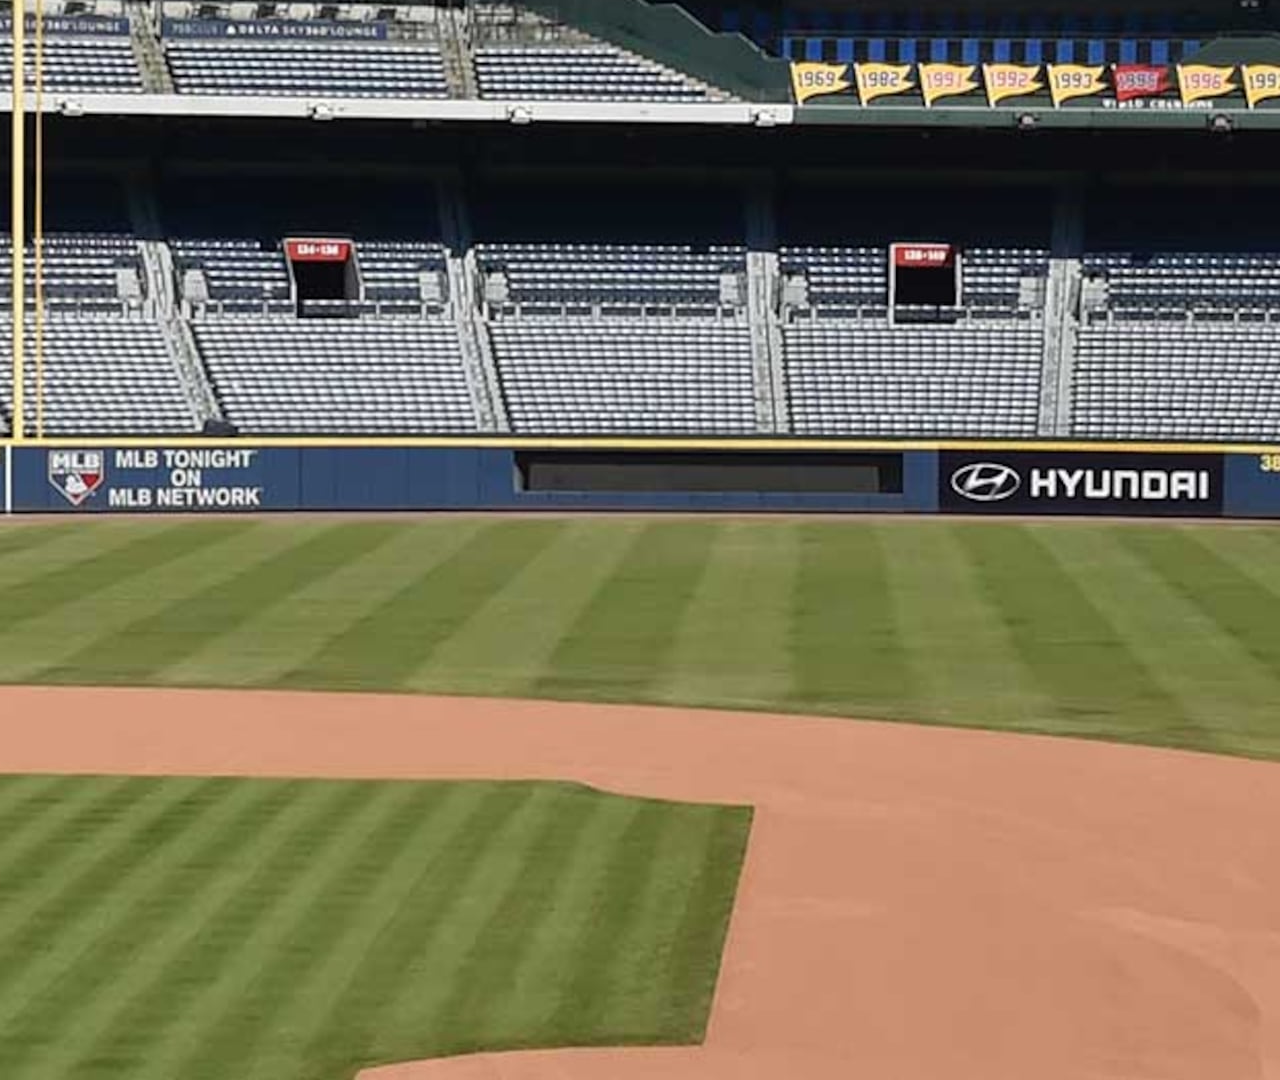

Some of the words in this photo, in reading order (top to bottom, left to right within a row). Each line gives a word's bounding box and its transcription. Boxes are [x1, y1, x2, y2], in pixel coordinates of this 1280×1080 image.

[240, 23, 280, 35] DELTA
[861, 71, 900, 88] 1982
[989, 71, 1029, 89] 1992
[1054, 73, 1092, 89] 1993
[52, 451, 100, 469] MLB
[116, 449, 158, 469] MLB
[163, 449, 252, 469] TONIGHT
[171, 469, 201, 487] ON
[1030, 468, 1210, 500] HYUNDAI
[108, 487, 152, 507] MLB
[156, 487, 259, 507] NETWORK
